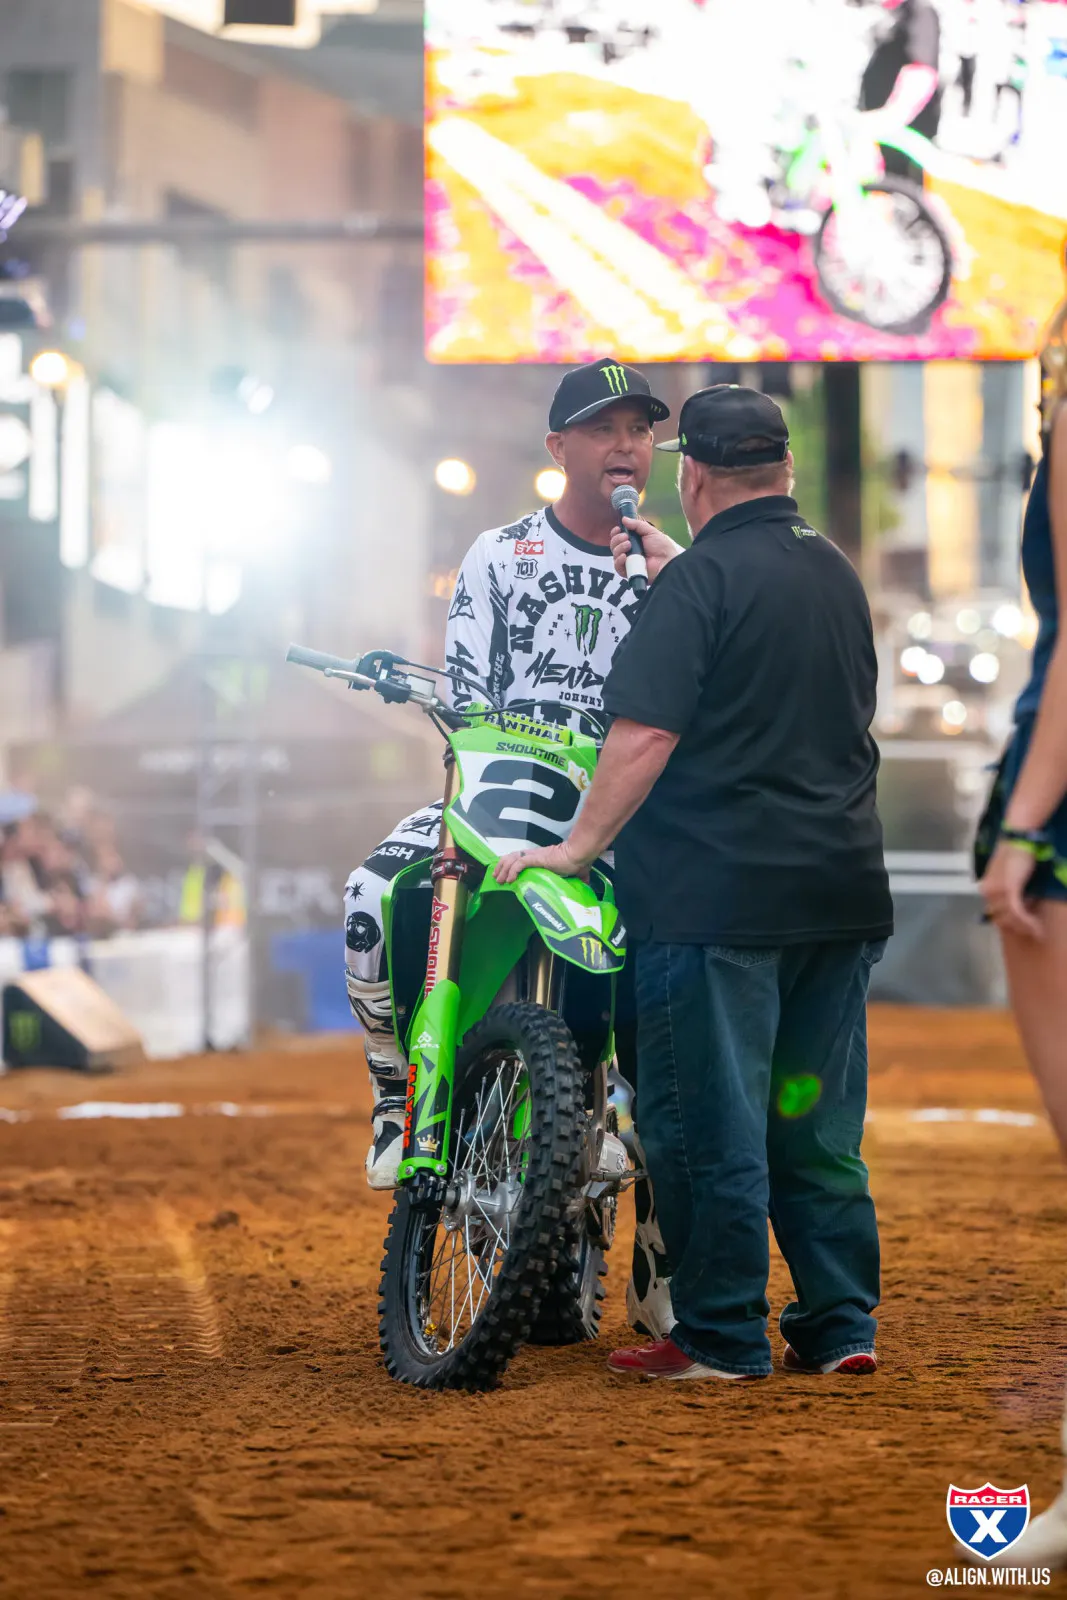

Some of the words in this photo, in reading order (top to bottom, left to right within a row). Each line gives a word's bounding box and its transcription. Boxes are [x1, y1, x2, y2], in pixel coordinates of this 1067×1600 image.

[496, 741, 567, 768] SHOWTIME
[466, 759, 582, 848] 2
[532, 902, 566, 932] Kawasaki
